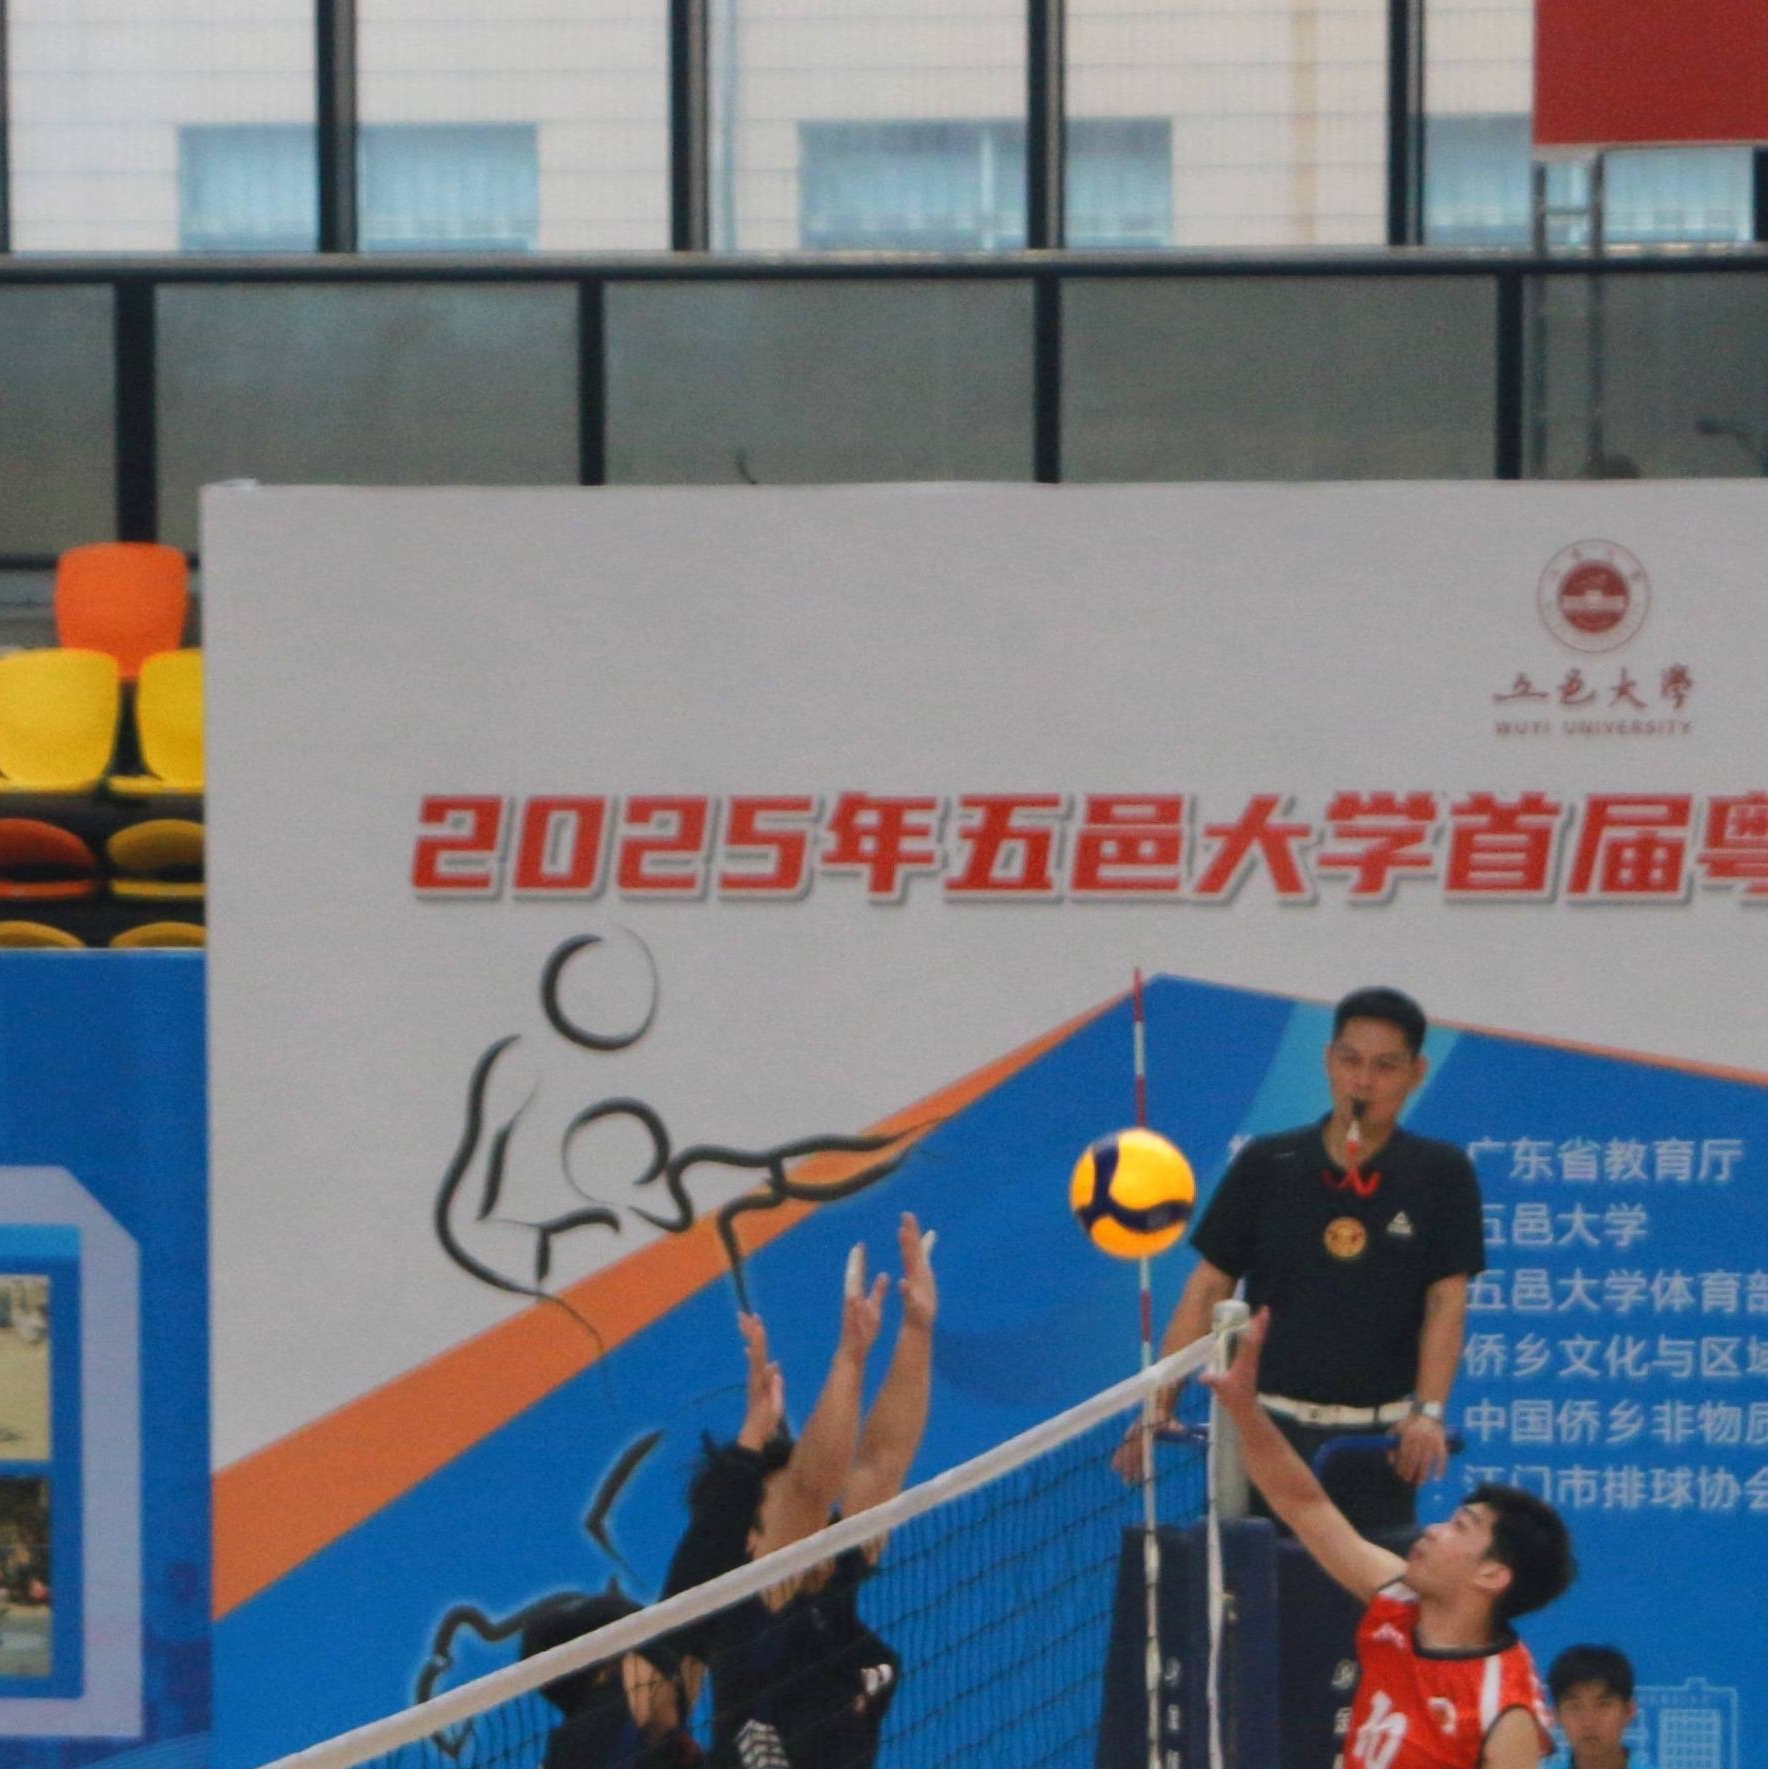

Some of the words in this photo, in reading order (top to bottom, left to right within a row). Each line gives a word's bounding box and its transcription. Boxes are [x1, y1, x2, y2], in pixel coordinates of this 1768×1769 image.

[1494, 720, 1551, 735] WUYI
[1563, 720, 1693, 735] UNIVERSITY
[1466, 1138, 1744, 1183] 广东省教育厅
